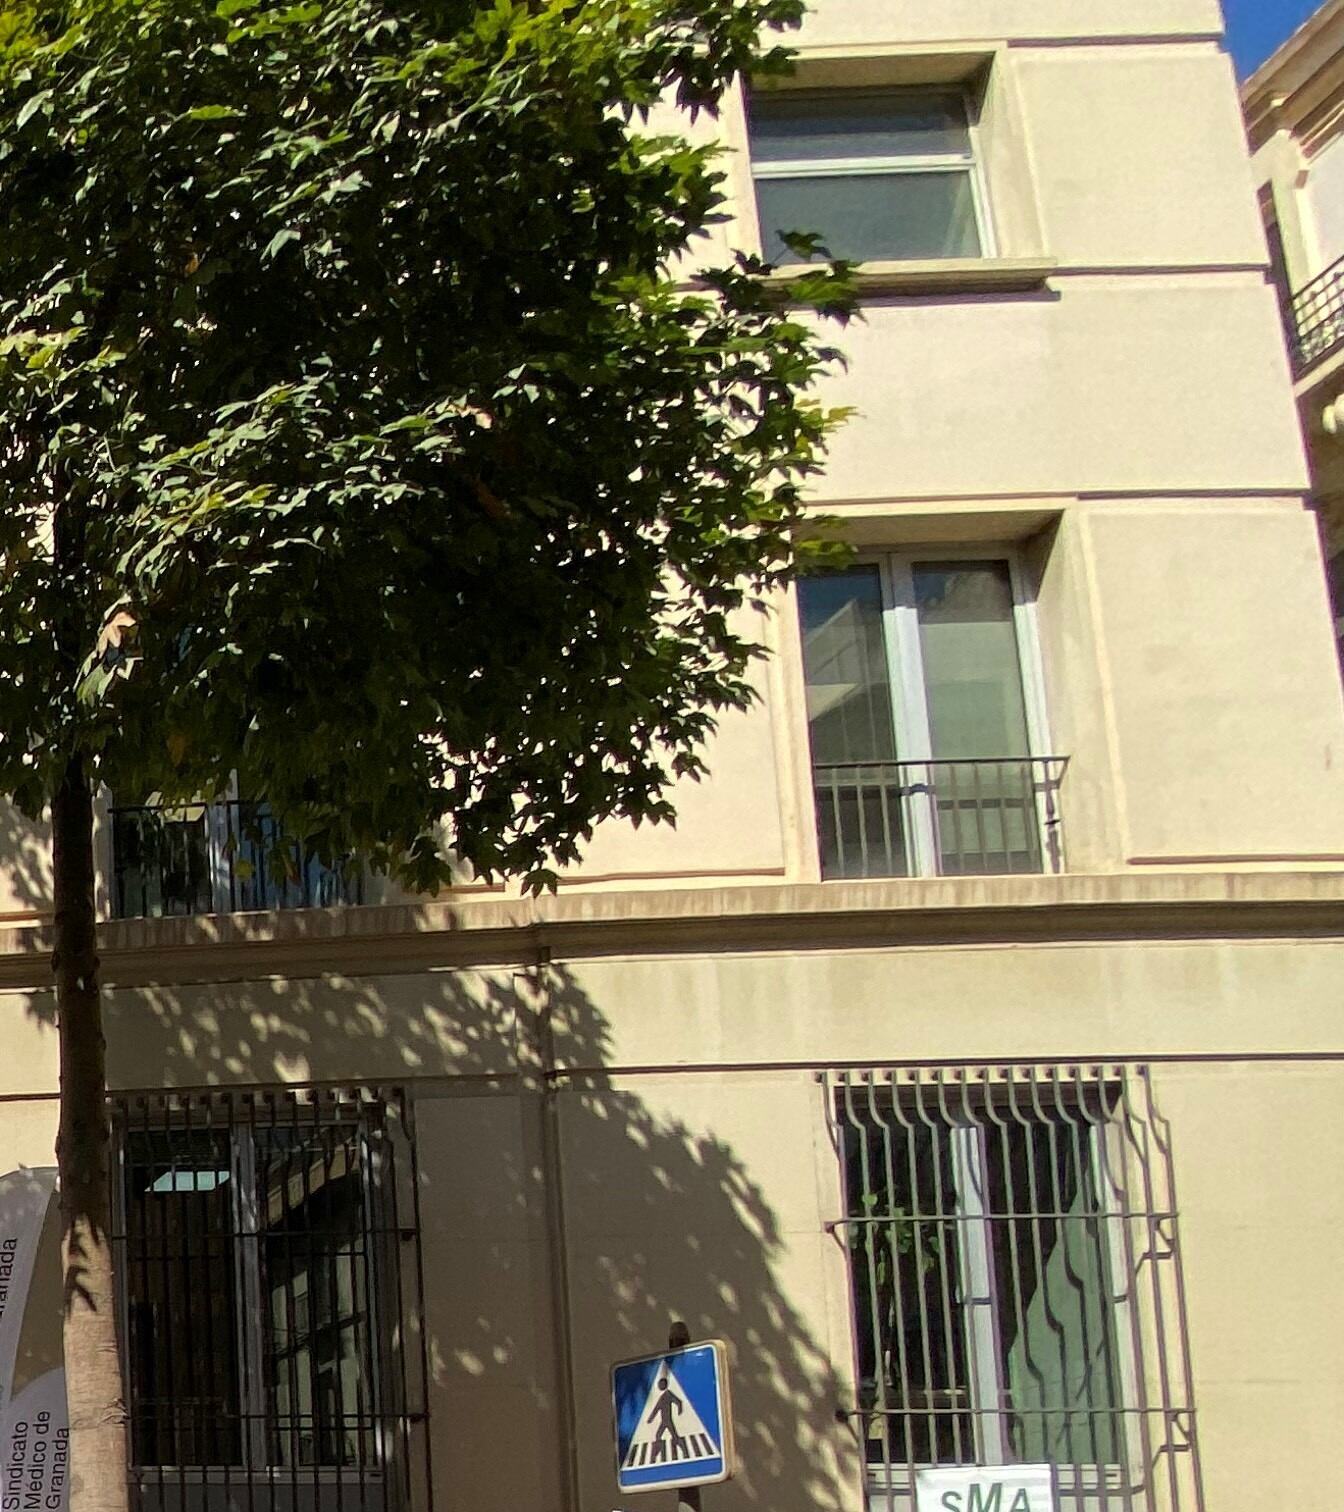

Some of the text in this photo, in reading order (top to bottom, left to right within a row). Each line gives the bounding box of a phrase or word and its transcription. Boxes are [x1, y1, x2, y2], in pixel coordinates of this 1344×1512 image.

[2, 1420, 30, 1511] Sindicato
[23, 1410, 52, 1511] Médico de
[45, 1426, 71, 1511] Granada
